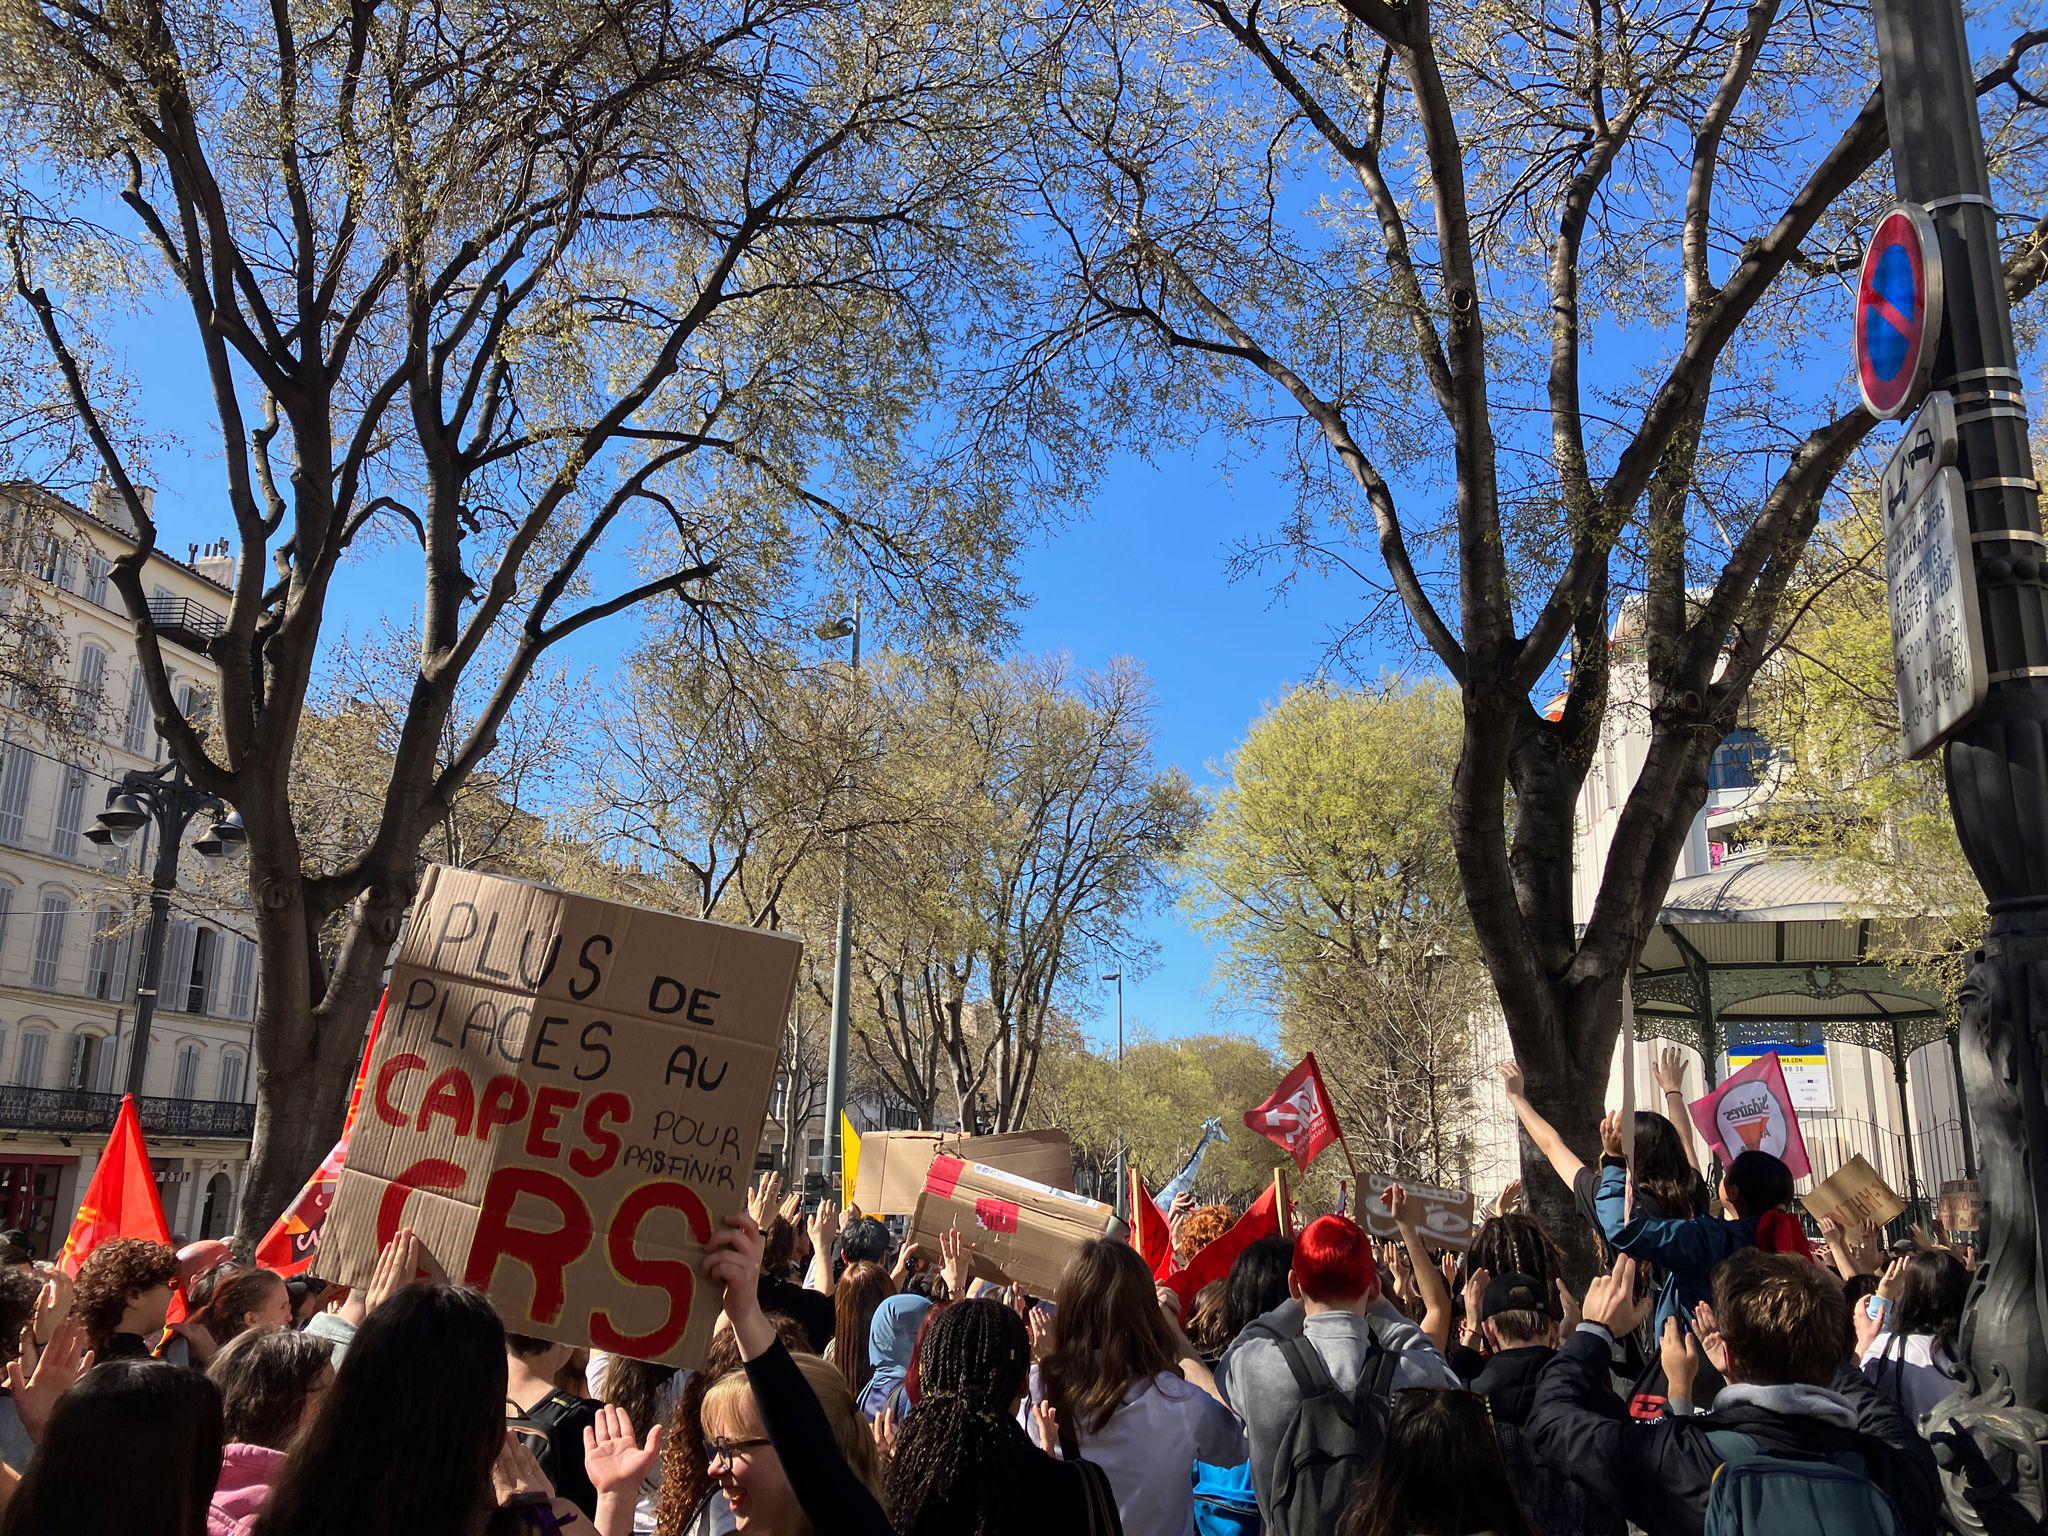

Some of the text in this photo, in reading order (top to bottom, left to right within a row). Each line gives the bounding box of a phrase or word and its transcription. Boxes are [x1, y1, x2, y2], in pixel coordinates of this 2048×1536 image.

[1894, 610, 1914, 644] MARDI
[1915, 599, 1923, 623] ET
[1925, 568, 1953, 613] SAMEDI
[1896, 585, 1903, 608] ET
[1904, 539, 1942, 598] FLEURISTES
[1926, 628, 1932, 646] A
[1936, 691, 1942, 710] A
[432, 902, 722, 1026] PLUS DE
[398, 978, 728, 1092] PLACES AU
[374, 1053, 633, 1179] CAPES
[652, 1110, 741, 1161] POUR
